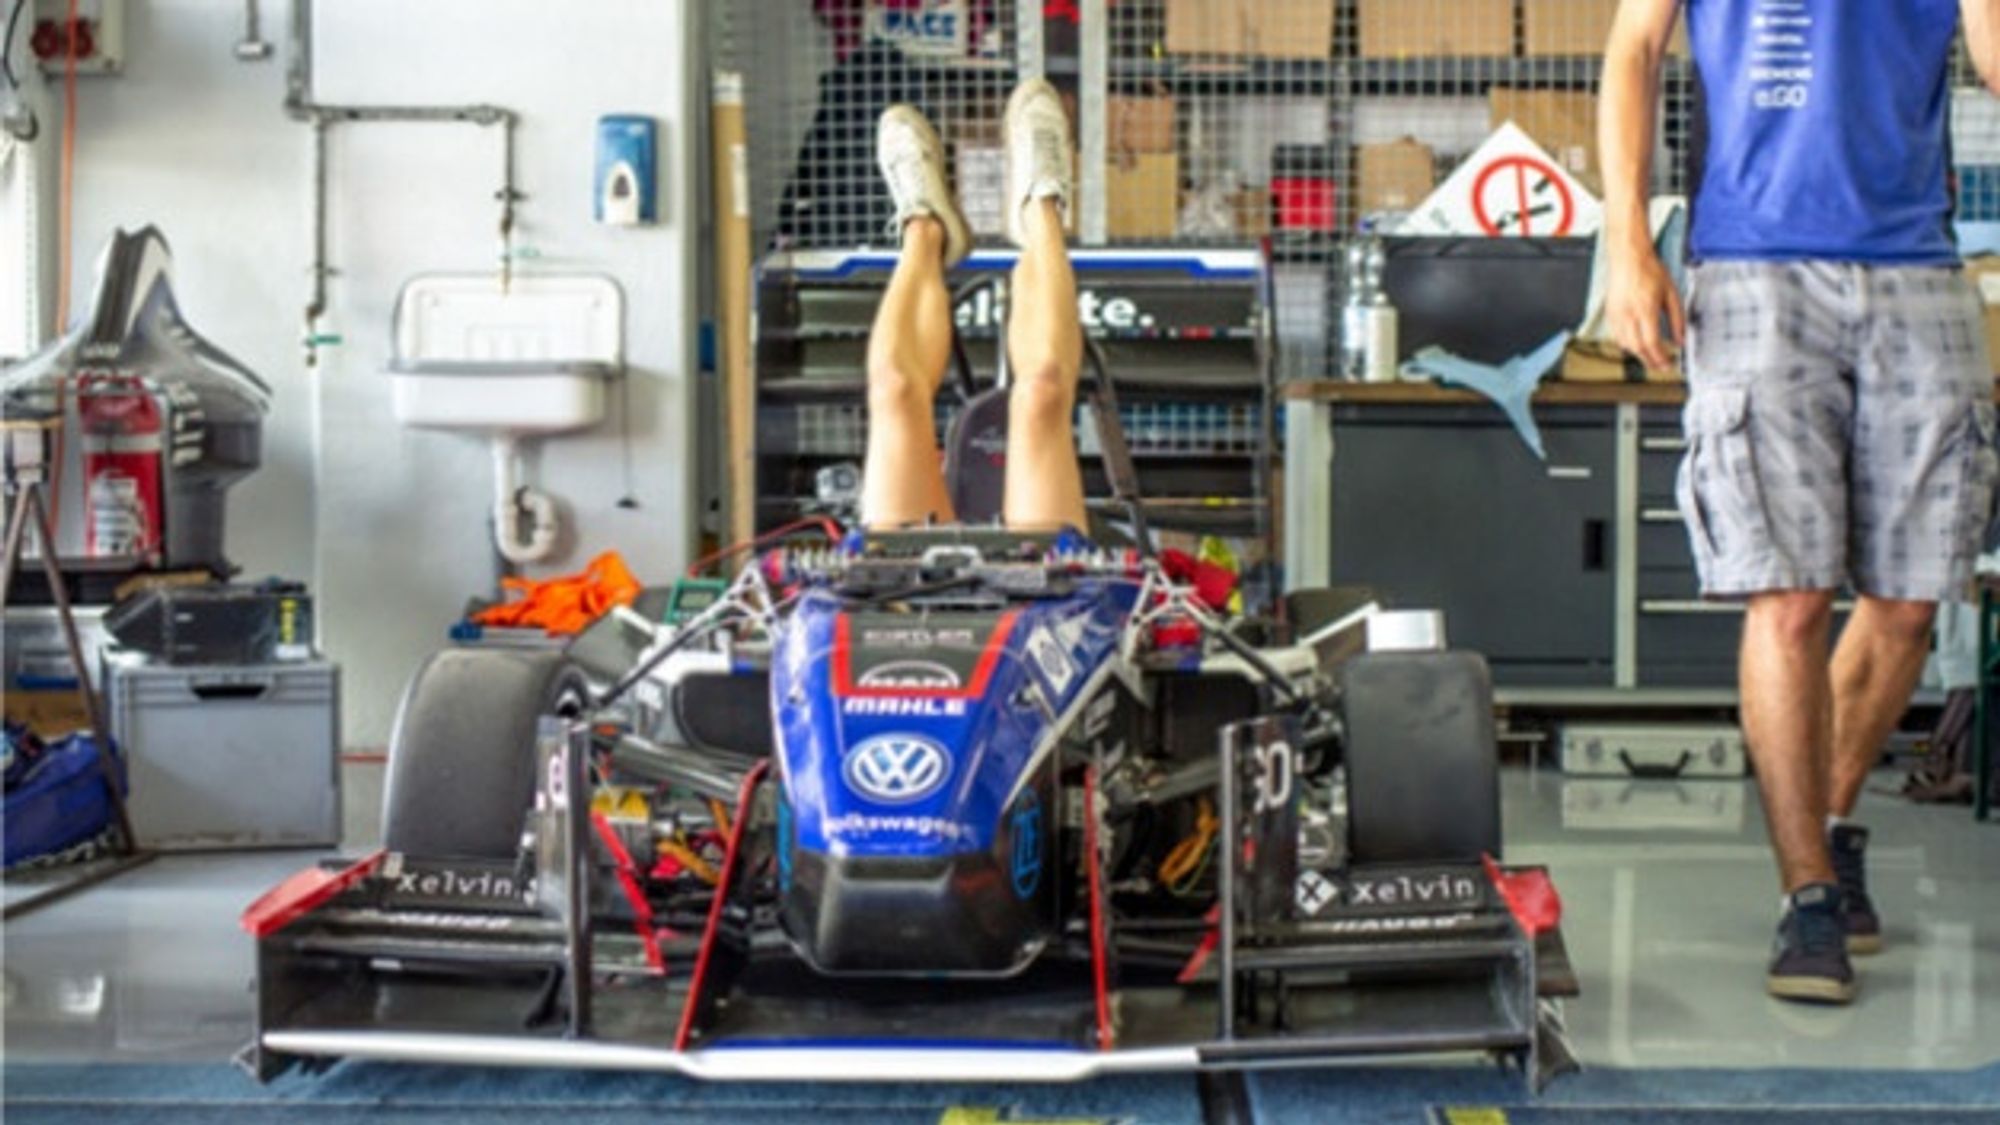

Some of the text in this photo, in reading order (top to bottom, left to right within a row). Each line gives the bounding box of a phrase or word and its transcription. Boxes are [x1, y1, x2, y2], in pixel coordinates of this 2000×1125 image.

[845, 698, 966, 715] MAHLE
[398, 870, 513, 896] xelvin
[1351, 874, 1475, 904] xelvin
